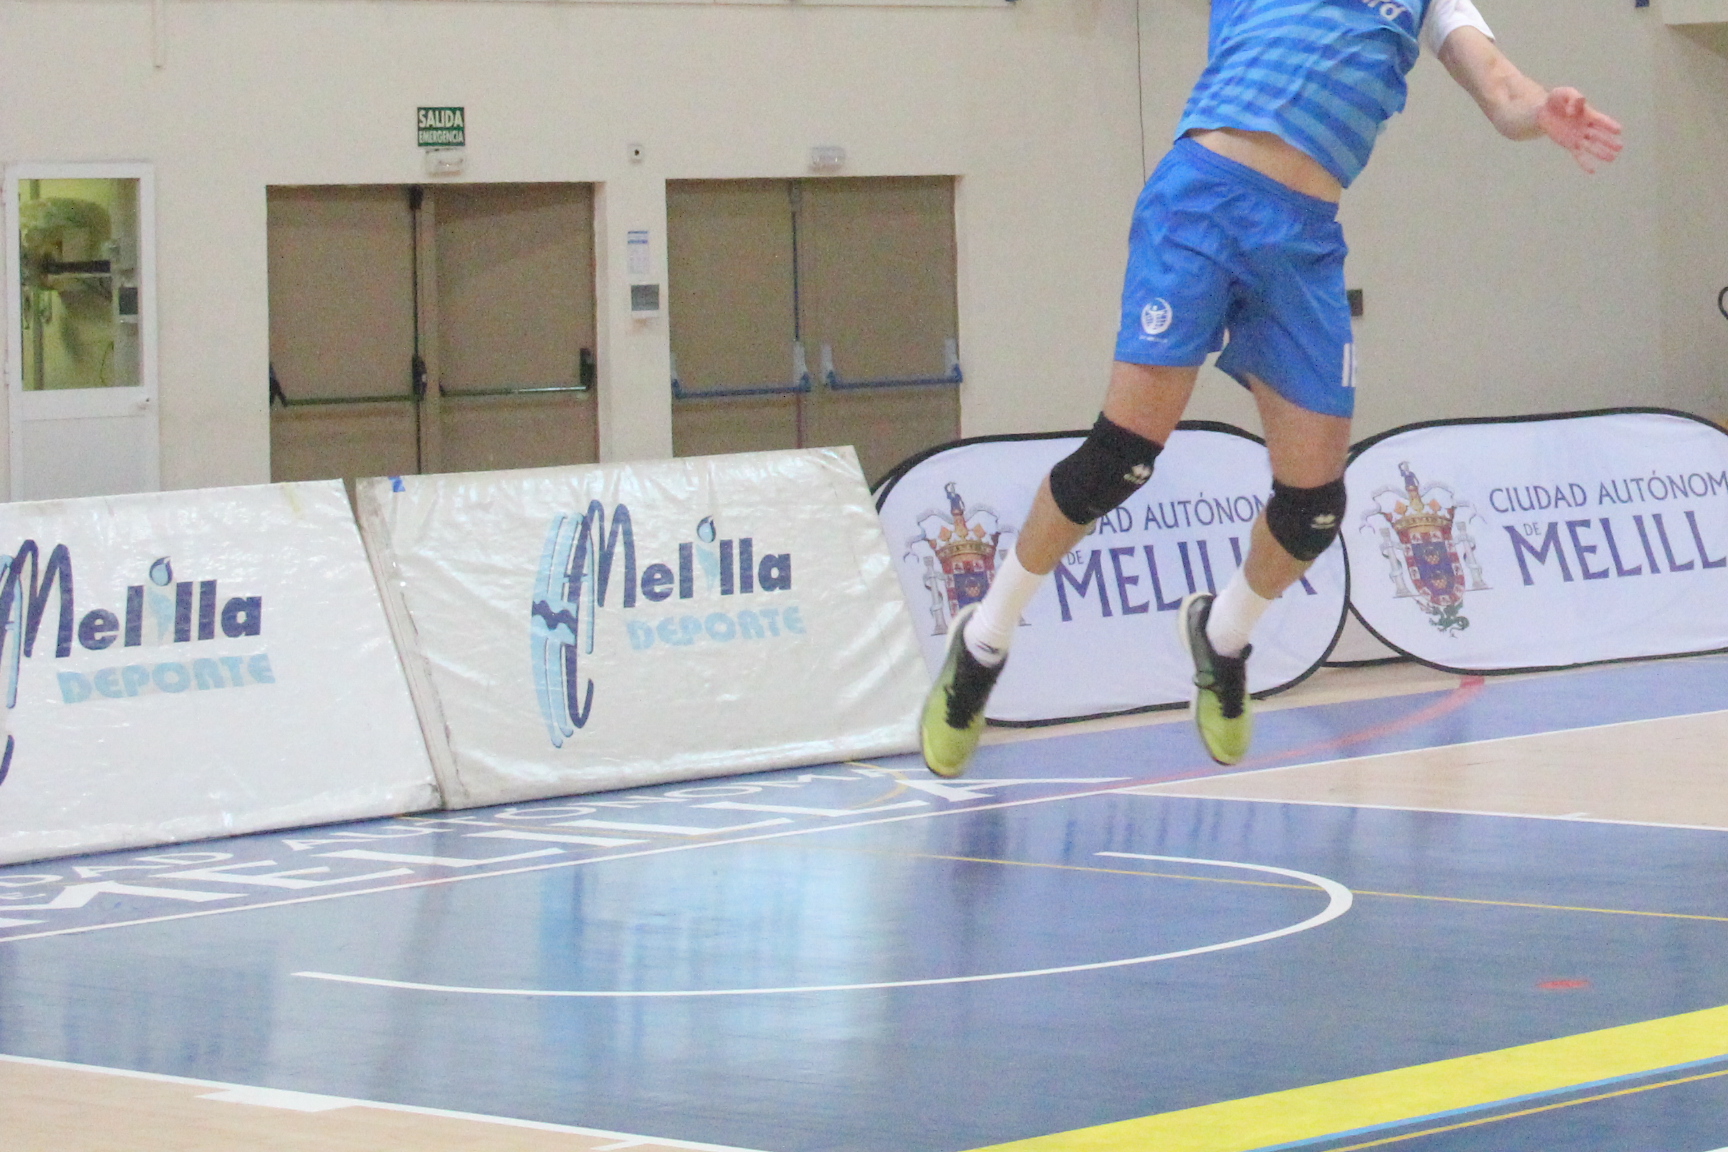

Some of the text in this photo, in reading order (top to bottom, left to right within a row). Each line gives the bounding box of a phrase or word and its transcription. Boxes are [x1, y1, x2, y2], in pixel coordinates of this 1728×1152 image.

[418, 109, 463, 128] SALIDA
[418, 129, 464, 144] EMERGENCIA
[1489, 481, 1589, 515] CIUDAD
[1522, 521, 1543, 538] DE
[1067, 550, 1084, 567] DE
[625, 605, 807, 650] DEPORTE
[56, 652, 275, 705] DEPORTE
